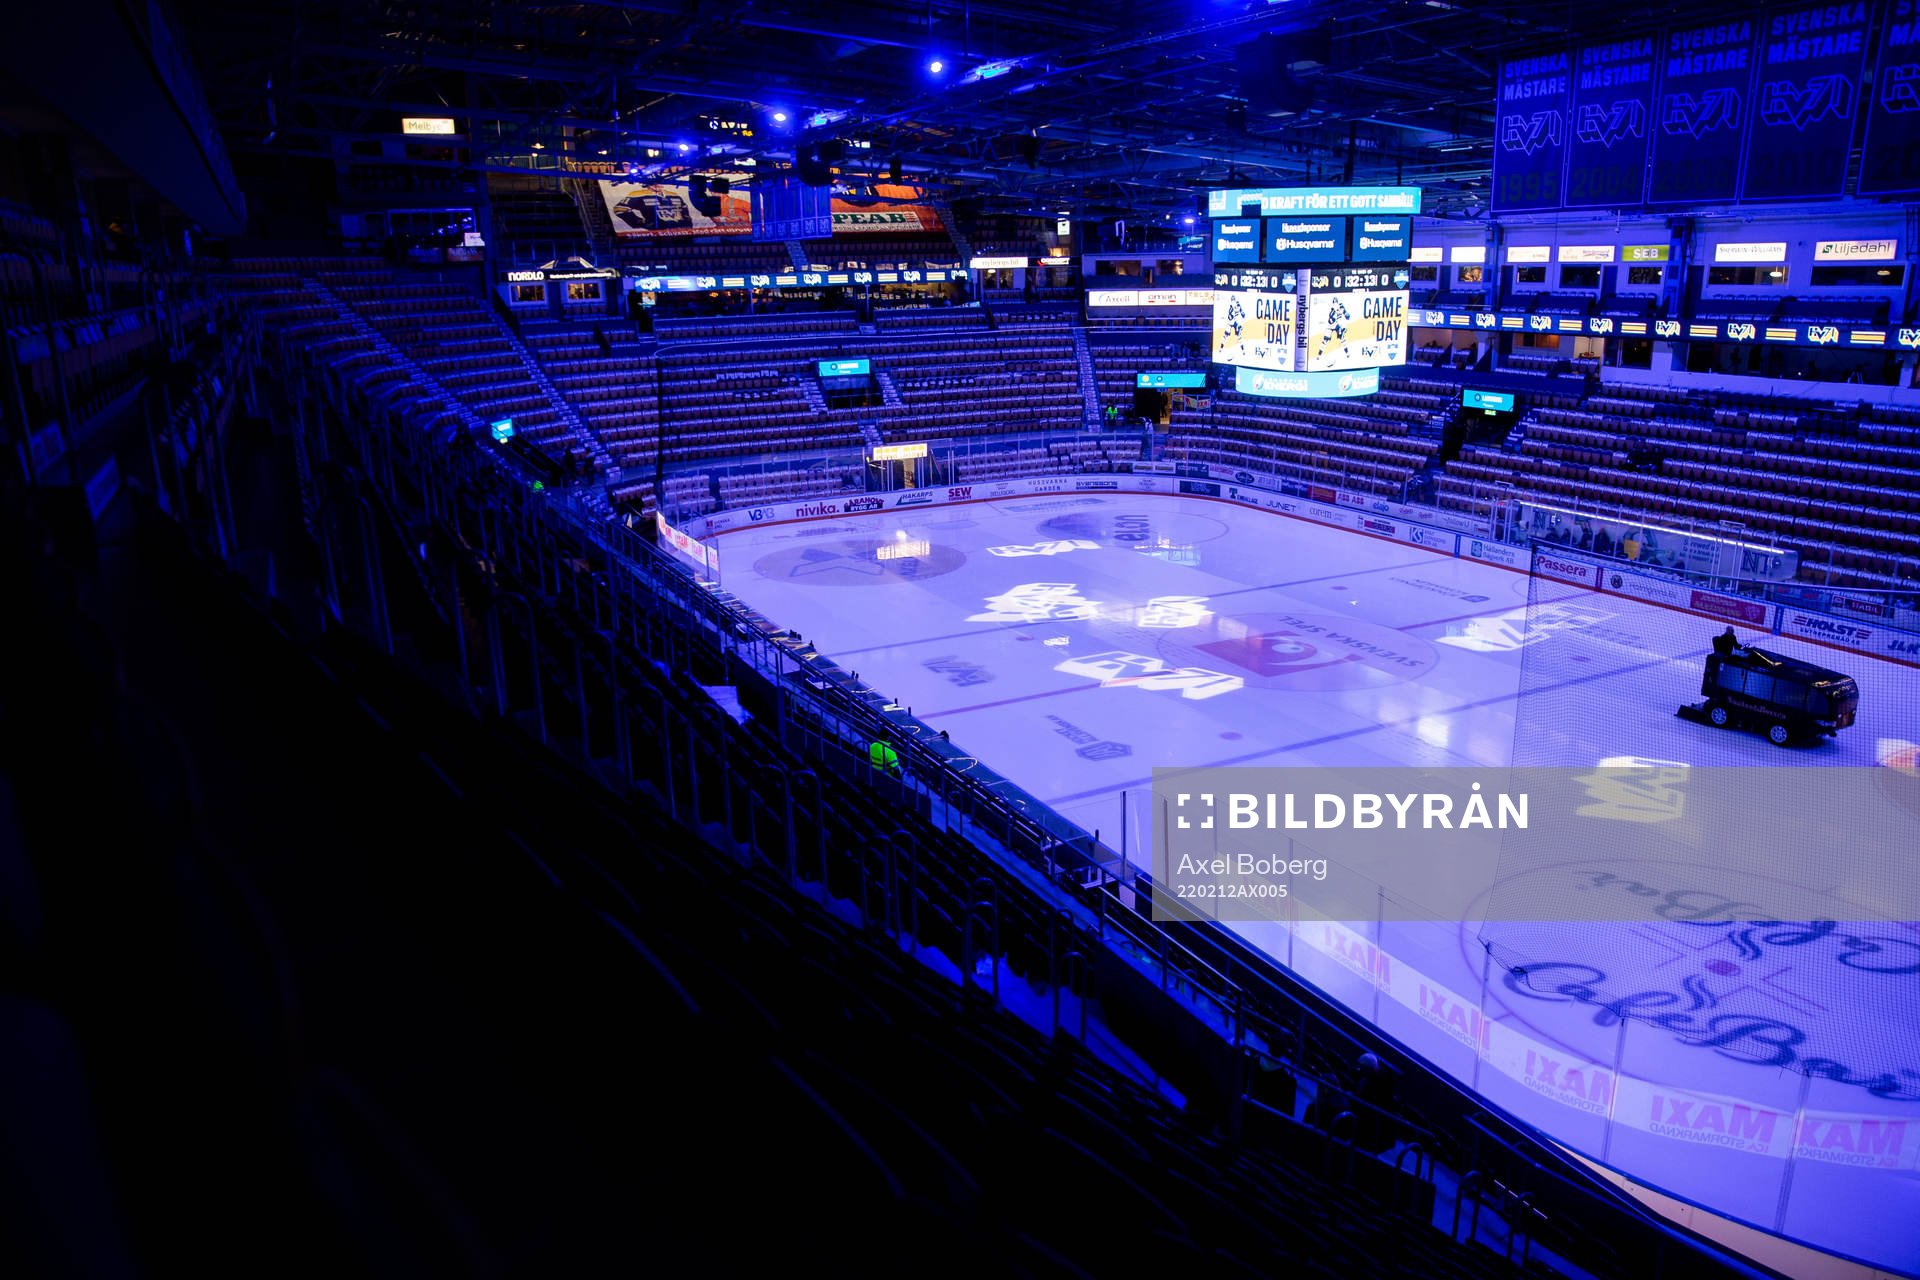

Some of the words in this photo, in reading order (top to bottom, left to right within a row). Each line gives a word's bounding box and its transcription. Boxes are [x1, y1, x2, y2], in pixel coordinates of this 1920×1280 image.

[1771, 2, 1865, 36] SVENSKA
[1671, 21, 1751, 52] SVENSKA
[1583, 38, 1653, 66] SVENSKA
[1768, 31, 1862, 65] MÄSTARE
[1505, 52, 1567, 79] SVENSKA
[1667, 47, 1748, 77] MÄSTARE
[1581, 62, 1650, 89] MÄSTARE
[1504, 76, 1565, 101] MÄSTARE
[1499, 169, 1557, 203] 1995
[1270, 195, 1304, 209] KRAFT
[1305, 193, 1328, 209] FÖR
[1329, 195, 1349, 208] ETT
[1350, 195, 1377, 208] GOTT
[833, 213, 905, 224] PEAB
[1287, 239, 1334, 250] Husqvarna
[1633, 248, 1658, 259] SEB
[1834, 242, 1891, 256] Liljedahl
[1333, 276, 1341, 287] 0
[1381, 274, 1389, 286] 0
[1256, 298, 1291, 321] GAME
[1297, 295, 1308, 335] nybergs
[1363, 297, 1402, 319] GAME
[1267, 323, 1290, 345] DAY
[1376, 320, 1401, 342] DAY
[1297, 337, 1308, 348] bil
[948, 487, 972, 497] SEW
[1351, 495, 1365, 505] ABB
[796, 501, 839, 517] nivika.
[1266, 500, 1297, 513] JUNET
[1309, 506, 1332, 519] corem
[1536, 555, 1587, 577] Passera
[1277, 615, 1326, 634] SPEL
[1806, 617, 1858, 638] HOLST
[1325, 632, 1424, 667] SVENSKA
